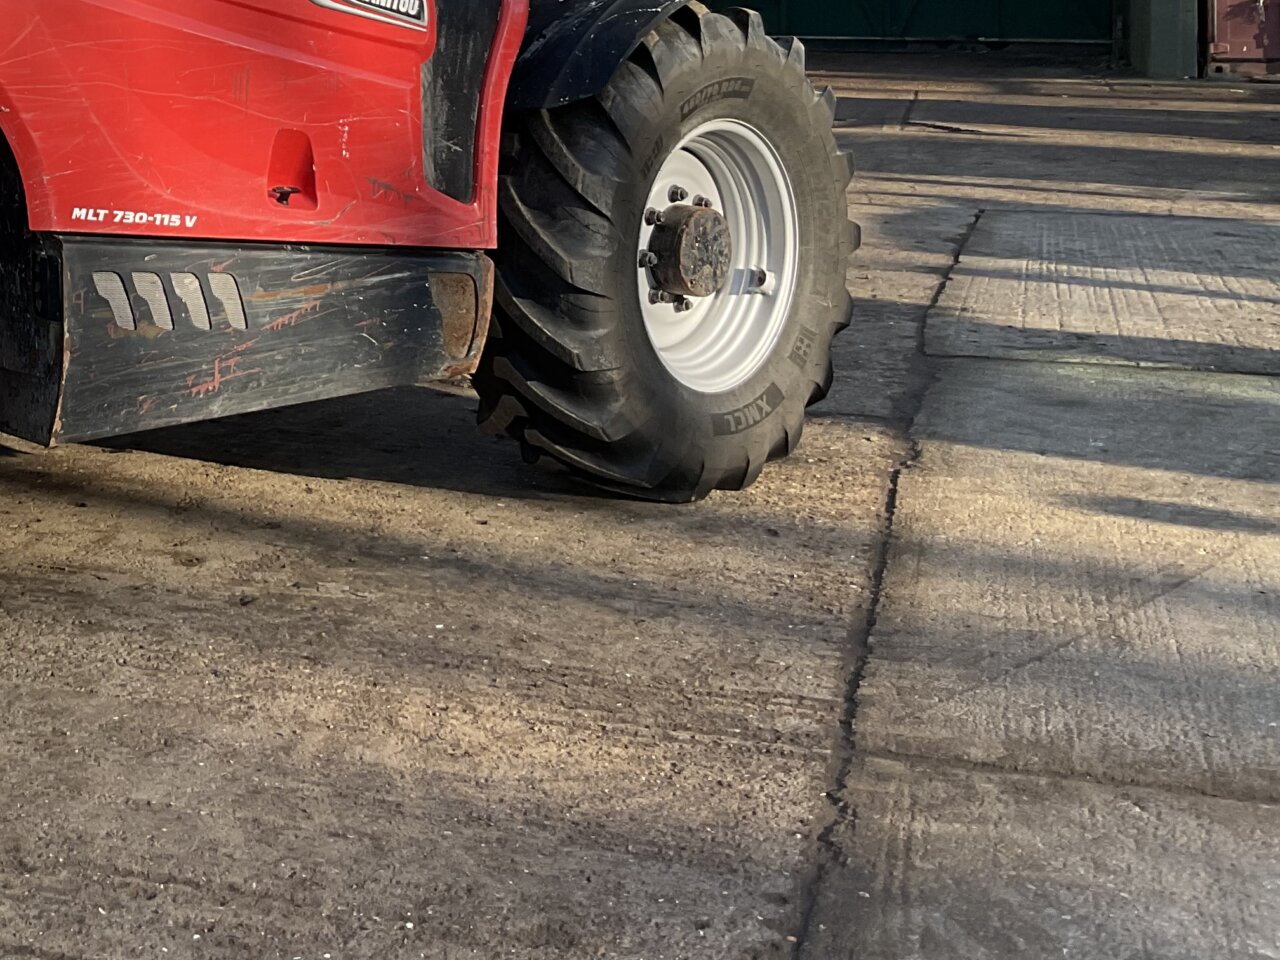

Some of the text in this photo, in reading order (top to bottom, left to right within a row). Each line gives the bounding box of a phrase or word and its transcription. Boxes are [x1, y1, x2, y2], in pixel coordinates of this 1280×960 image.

[71, 207, 198, 228] MLT 730-115 V
[724, 394, 772, 432] XMCL
